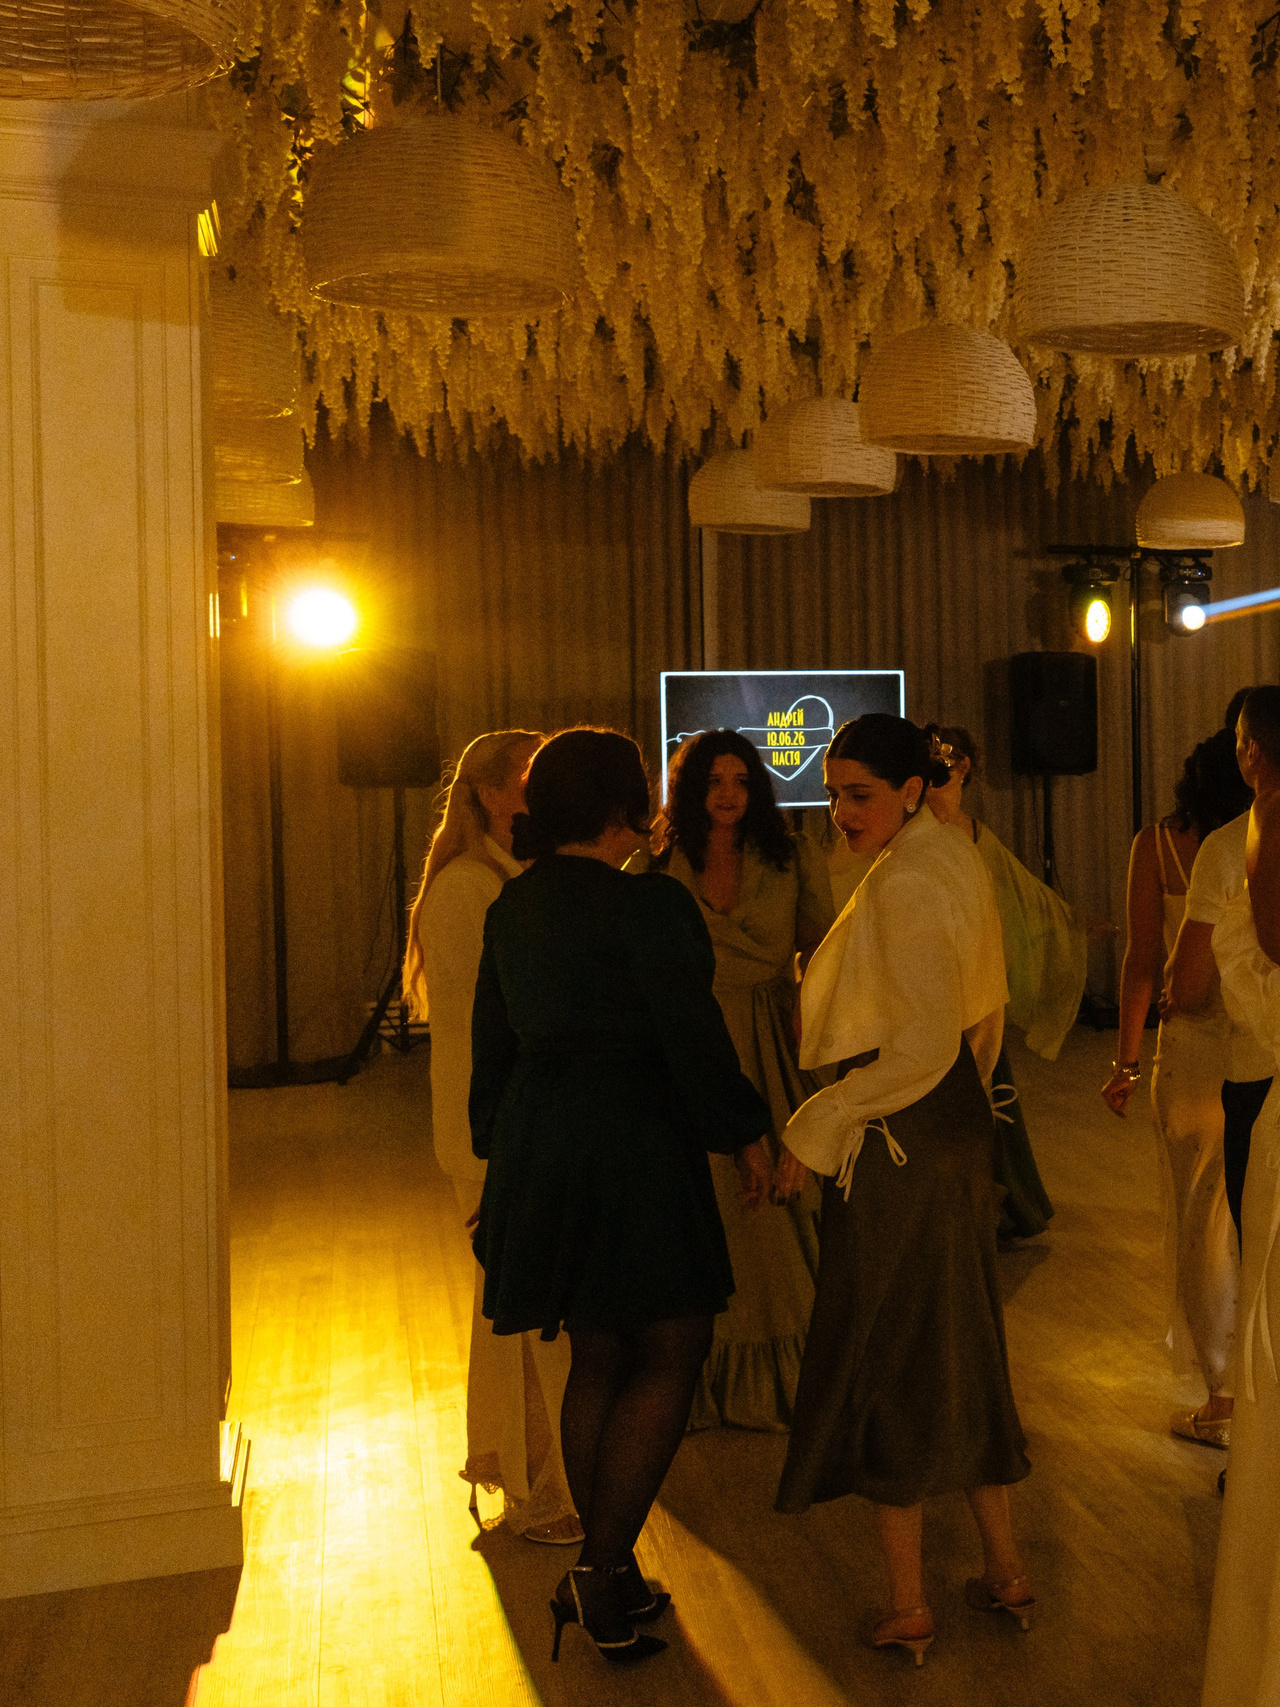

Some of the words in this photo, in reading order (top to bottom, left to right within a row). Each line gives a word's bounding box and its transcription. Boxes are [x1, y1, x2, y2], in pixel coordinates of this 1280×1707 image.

[767, 709, 804, 728] АНДРЕЙ
[767, 731, 805, 746] 18.06.26
[772, 751, 800, 766] НАСТЯ
